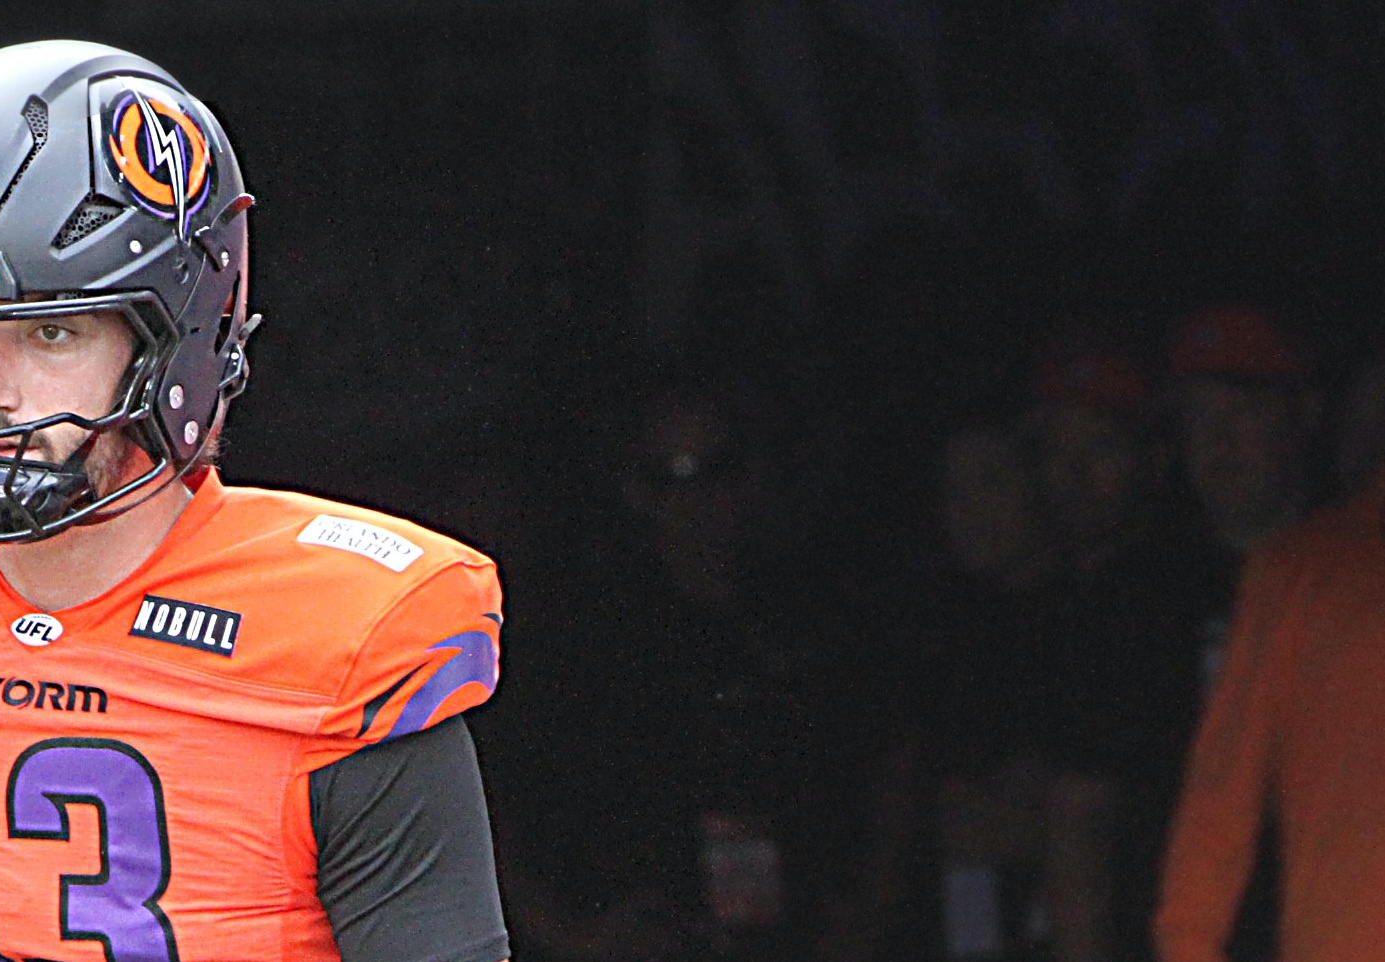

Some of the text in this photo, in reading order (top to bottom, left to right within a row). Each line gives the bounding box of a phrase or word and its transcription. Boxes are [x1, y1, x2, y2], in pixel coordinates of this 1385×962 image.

[317, 519, 412, 556] RLANDO
[15, 617, 53, 643] UFL
[133, 600, 234, 650] NOBULL
